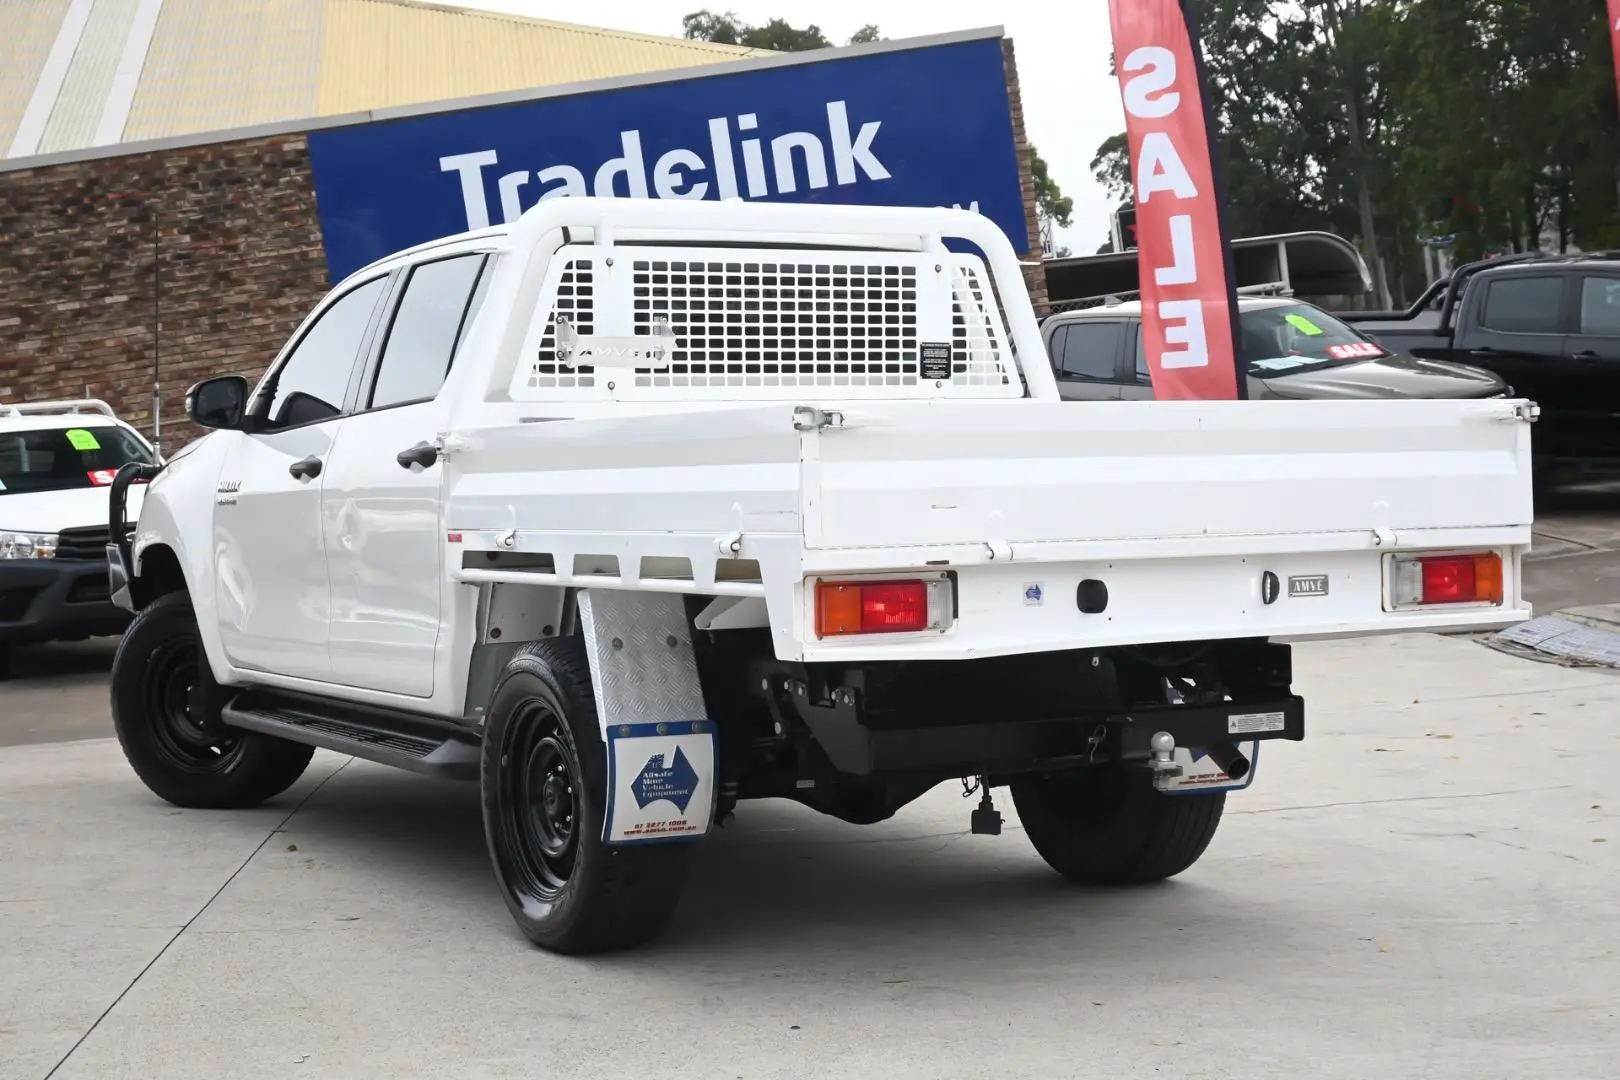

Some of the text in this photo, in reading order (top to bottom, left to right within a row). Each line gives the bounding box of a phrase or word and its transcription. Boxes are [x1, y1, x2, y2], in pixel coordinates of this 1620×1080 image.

[439, 100, 892, 231] Tradelink
[1330, 343, 1384, 359] SALE
[1294, 580, 1323, 592] AMVE
